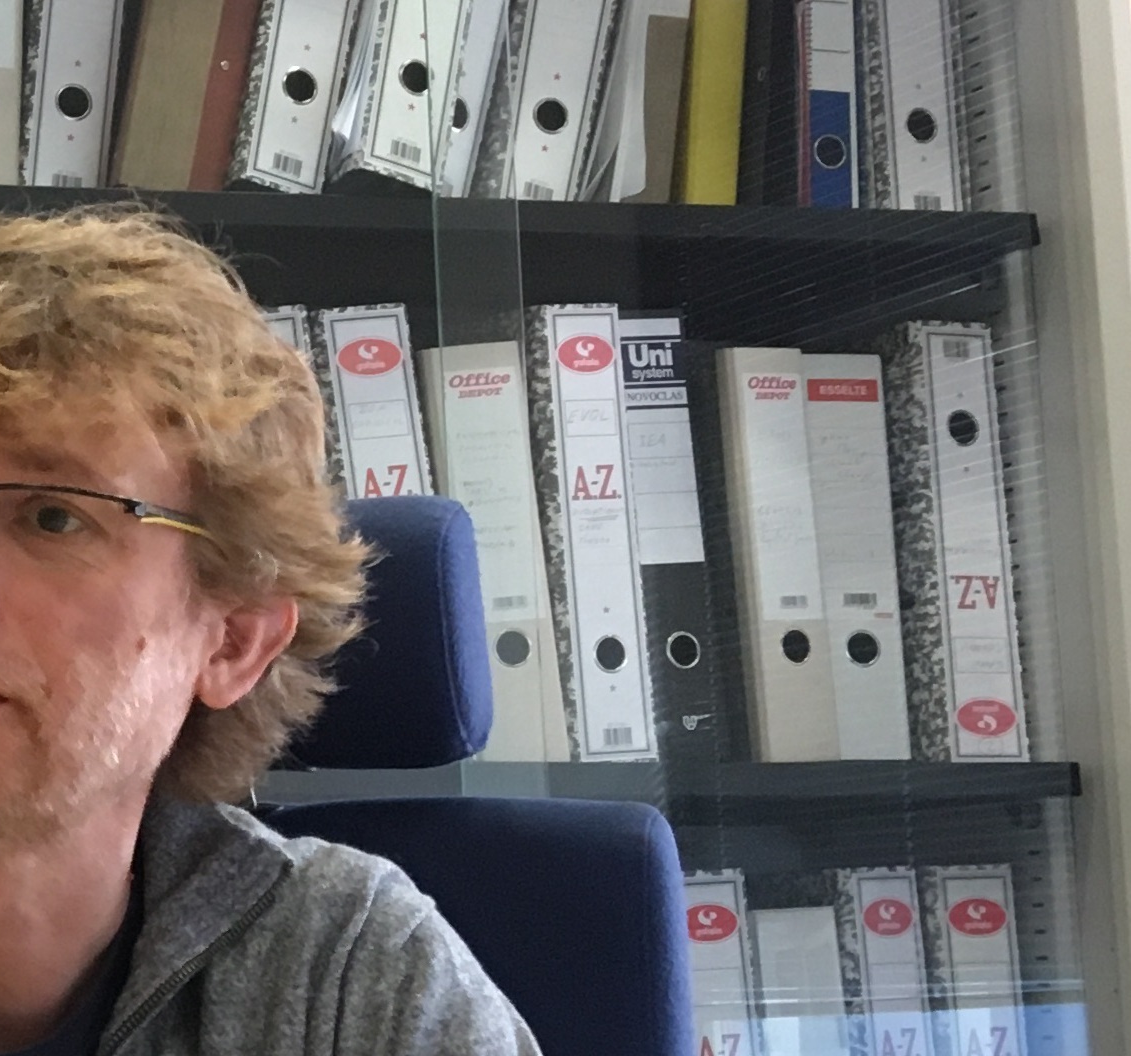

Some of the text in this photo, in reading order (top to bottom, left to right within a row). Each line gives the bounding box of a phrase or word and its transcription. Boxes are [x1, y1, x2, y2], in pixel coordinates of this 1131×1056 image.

[627, 342, 674, 368] Uni
[449, 371, 511, 388] Office
[631, 367, 674, 382] system
[747, 375, 797, 390] Office
[818, 384, 868, 396] ESSELTE
[457, 387, 503, 399] DEPOT
[627, 390, 684, 402] NOVOCLAS
